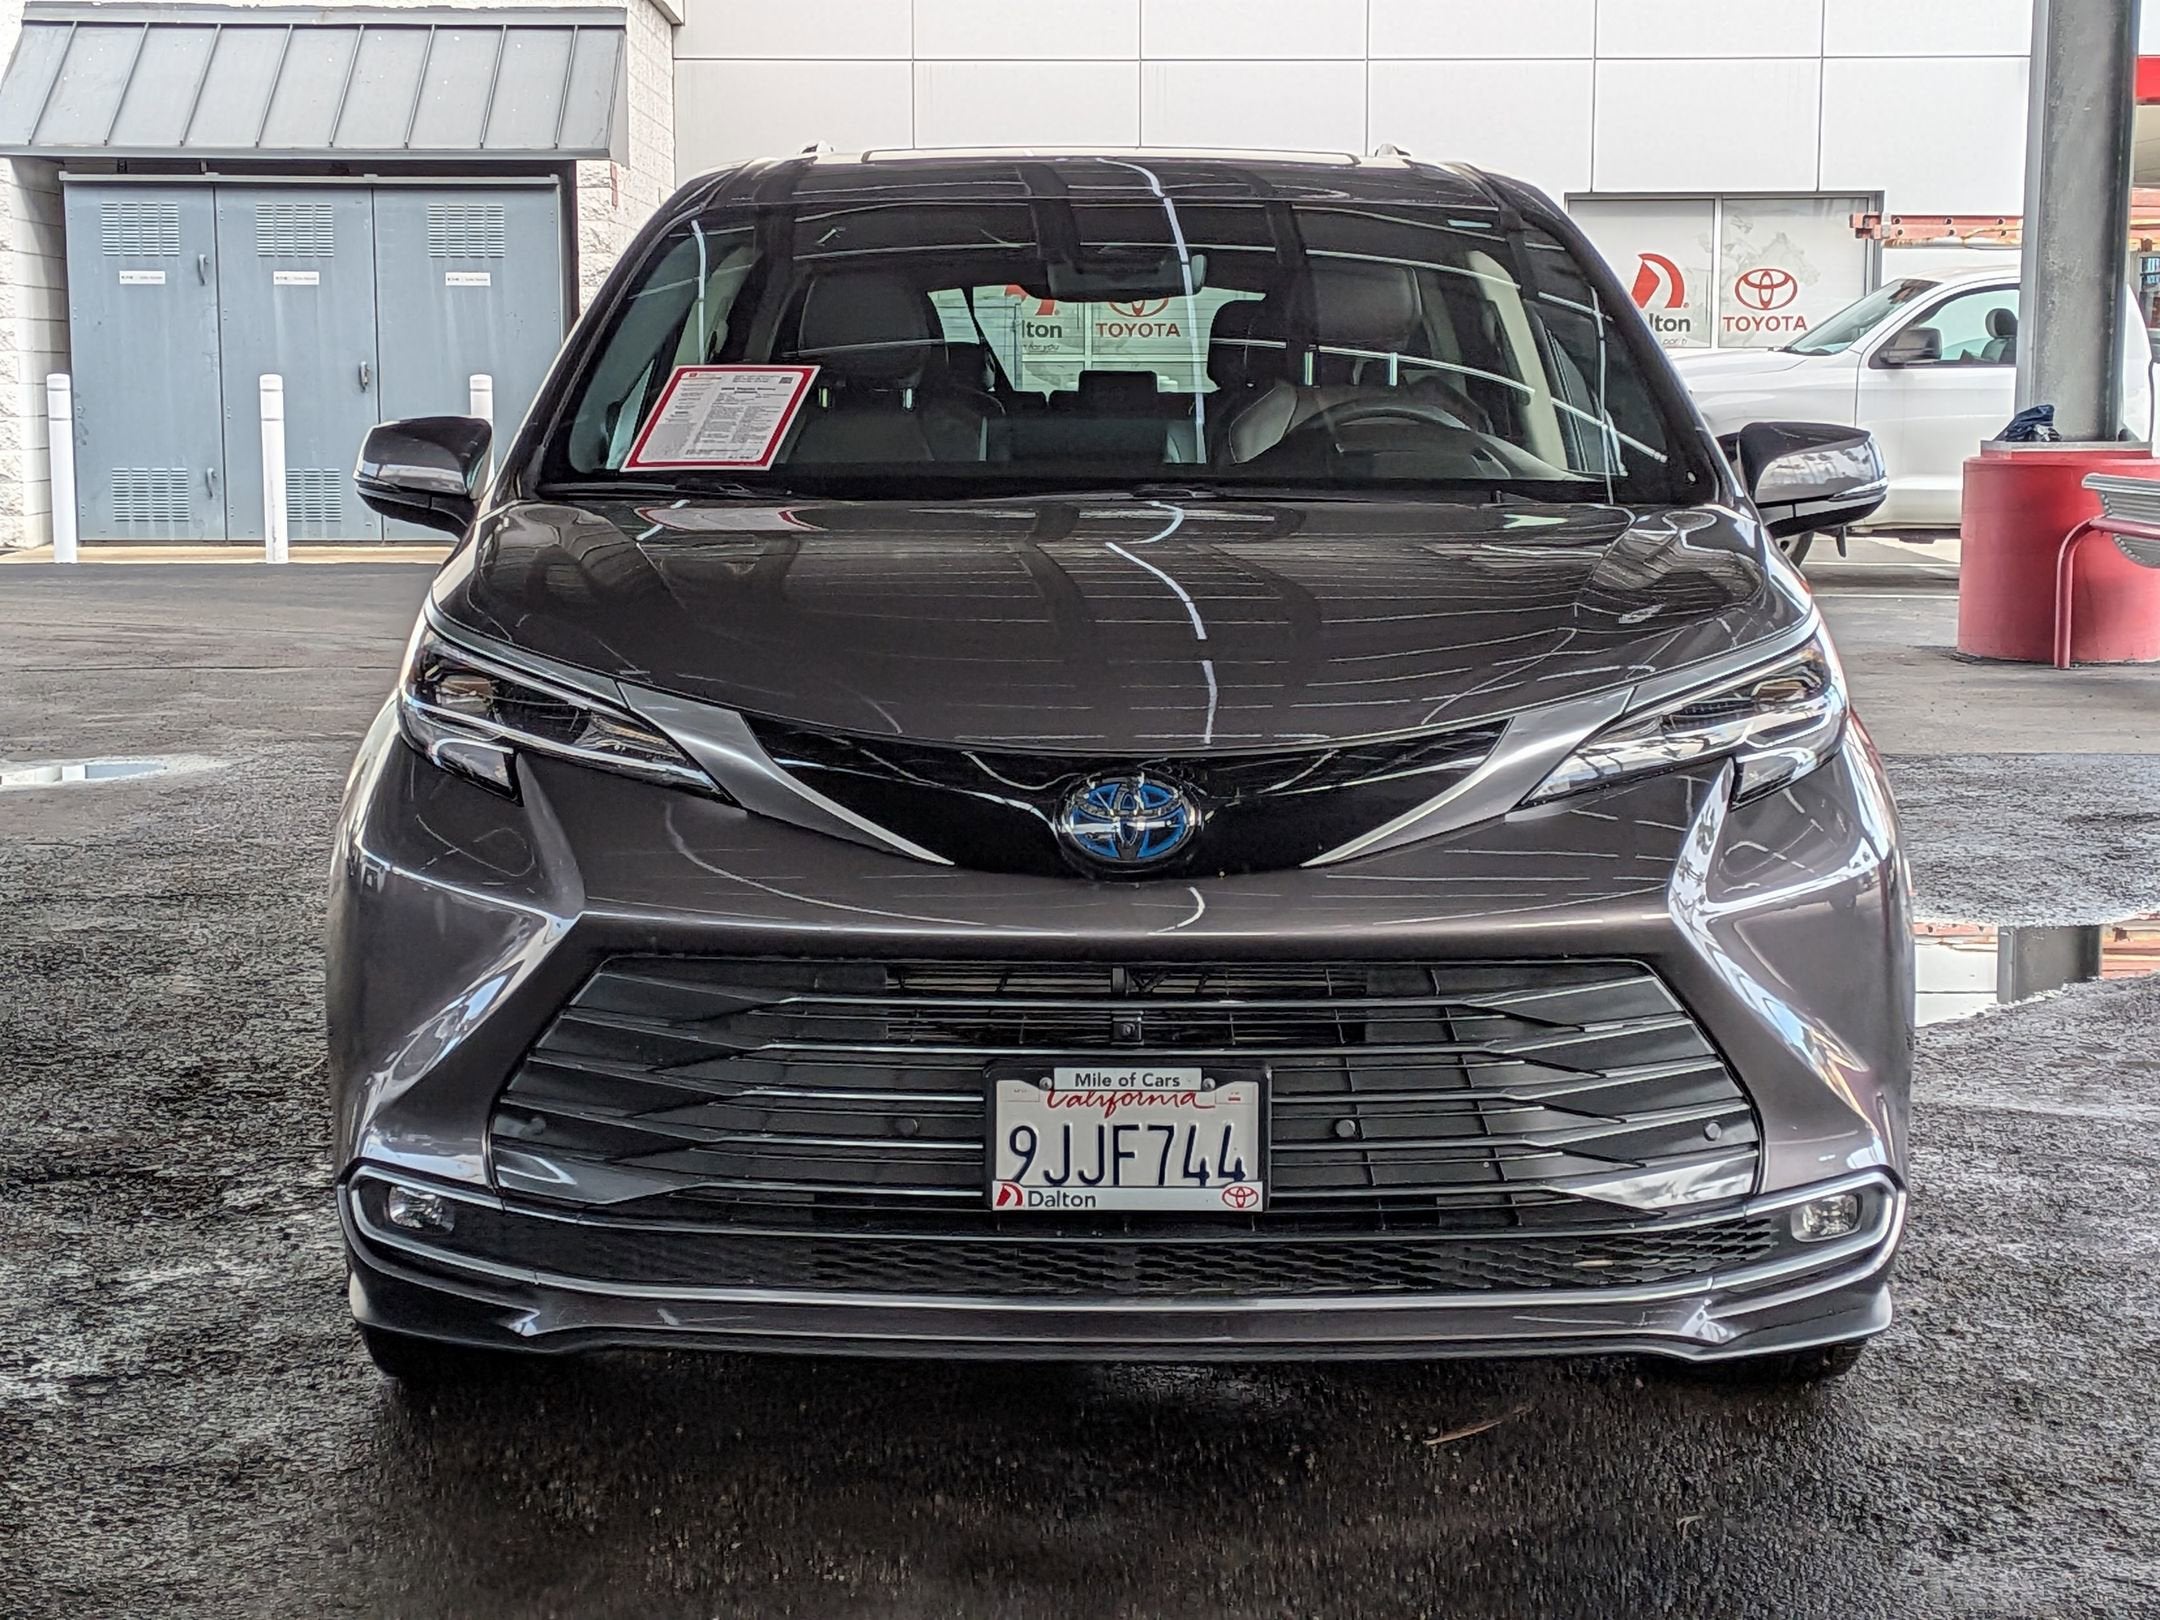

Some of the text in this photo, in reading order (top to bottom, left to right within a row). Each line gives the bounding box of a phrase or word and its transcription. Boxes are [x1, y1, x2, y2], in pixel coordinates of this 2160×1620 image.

[1021, 319, 1063, 338] lton
[1095, 322, 1181, 338] TOYOTA
[1649, 313, 1691, 332] lton
[1723, 316, 1808, 332] TOYOTA
[1075, 1073, 1181, 1088] Mile of Cars
[1046, 1090, 1216, 1119] California
[1009, 1123, 1246, 1186] 9JJF744
[1027, 1190, 1097, 1208] Dalton
